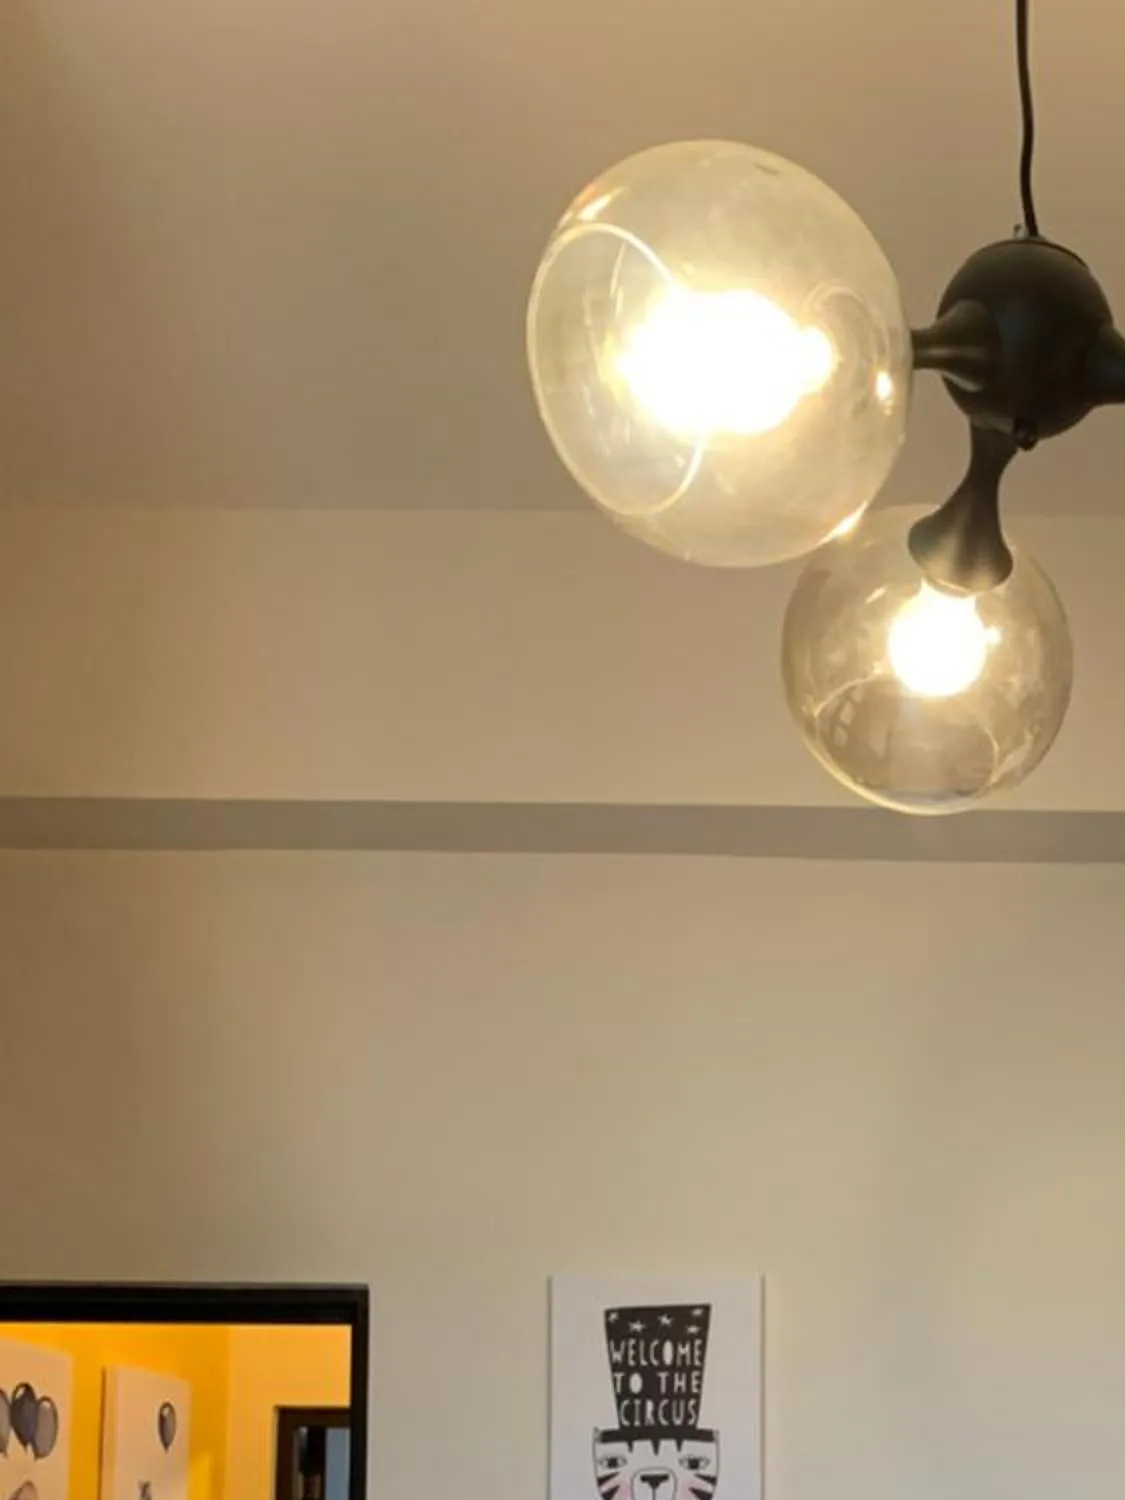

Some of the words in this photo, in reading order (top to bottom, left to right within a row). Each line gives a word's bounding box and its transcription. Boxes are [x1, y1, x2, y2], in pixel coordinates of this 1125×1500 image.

[610, 1338, 703, 1366] WELCOME
[613, 1372, 643, 1393] TO
[657, 1371, 701, 1393] THE
[619, 1400, 697, 1426] CIRCUS
